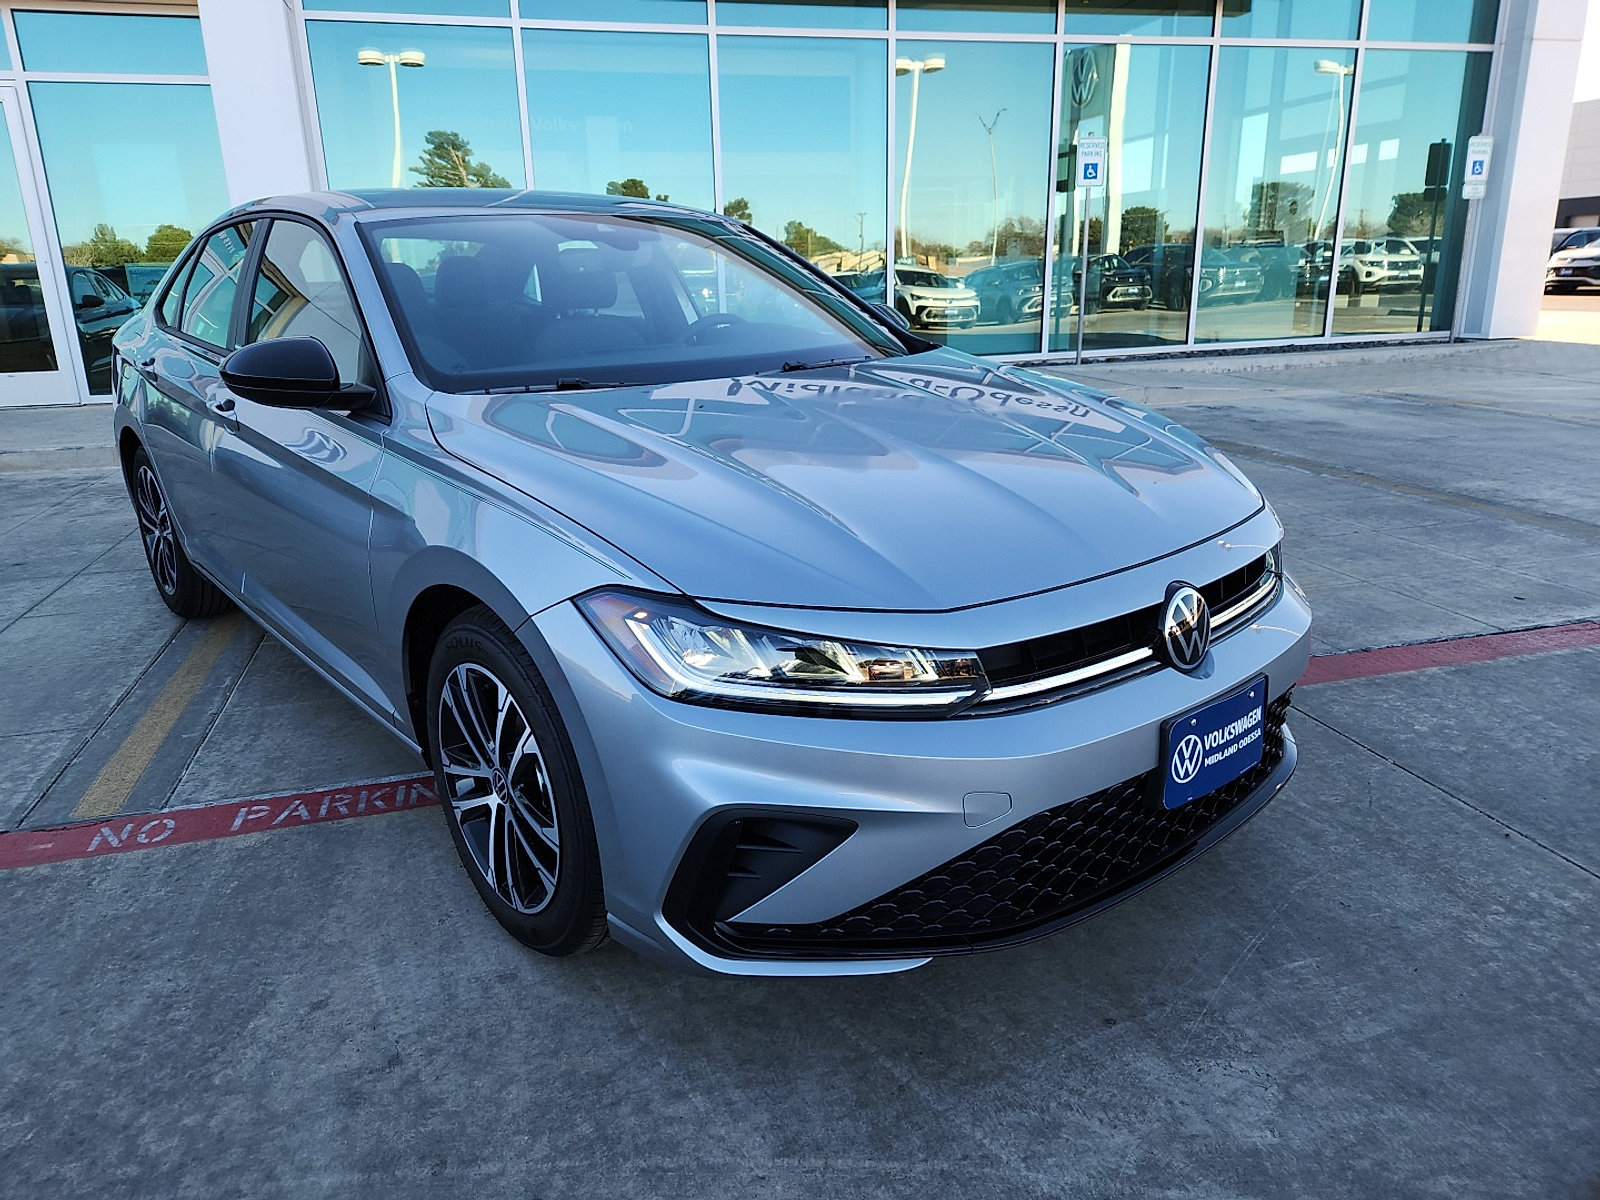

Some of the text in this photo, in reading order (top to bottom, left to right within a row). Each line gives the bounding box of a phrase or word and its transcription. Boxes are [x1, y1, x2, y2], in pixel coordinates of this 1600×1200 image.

[1203, 705, 1262, 751] VOLKSWAGEN
[1204, 743, 1238, 768] MIDLAND
[1238, 727, 1262, 749] ODESSA
[1171, 734, 1203, 784] VW
[86, 782, 440, 852] NO PARKIN
